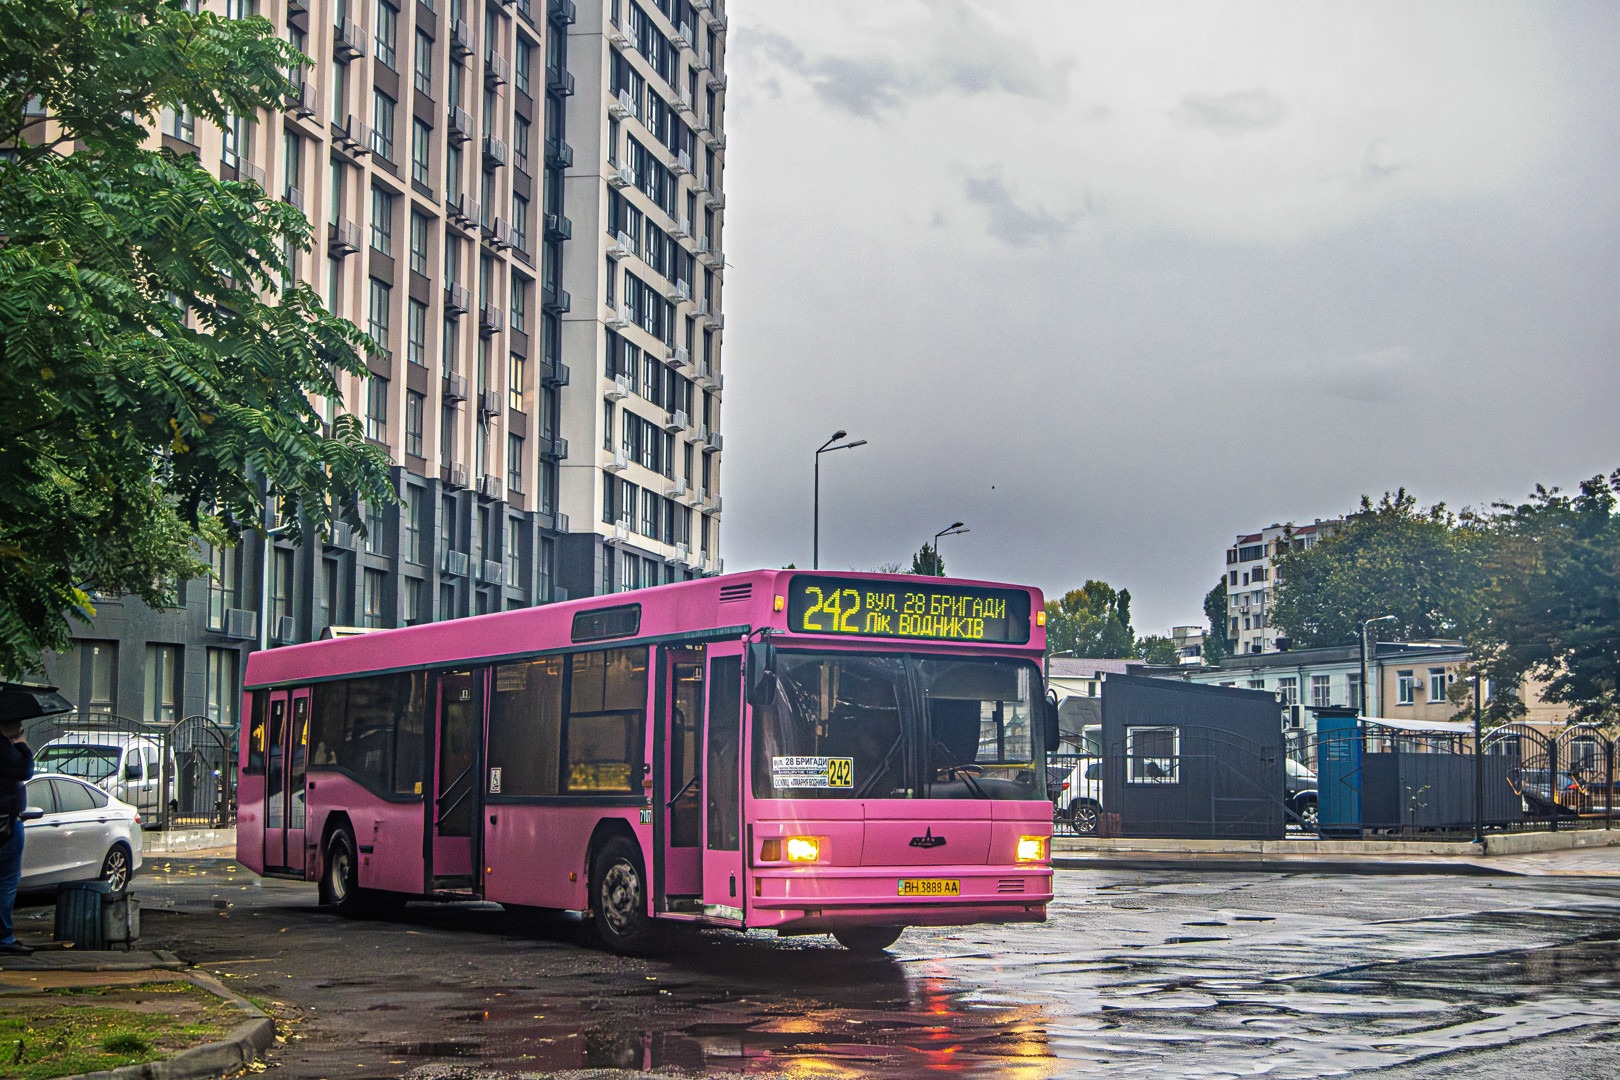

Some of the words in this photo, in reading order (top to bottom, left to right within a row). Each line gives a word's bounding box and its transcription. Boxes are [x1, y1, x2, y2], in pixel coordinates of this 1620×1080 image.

[803, 586, 862, 632] 242
[904, 593, 926, 614] 28
[930, 595, 1006, 619] БРИГАДИ
[898, 614, 984, 639] ВОДНИКІВ
[785, 757, 794, 766] 28
[795, 757, 827, 767] БРИГАДИ
[830, 760, 850, 785] 242
[904, 881, 919, 893] BH
[944, 881, 958, 893] AA
